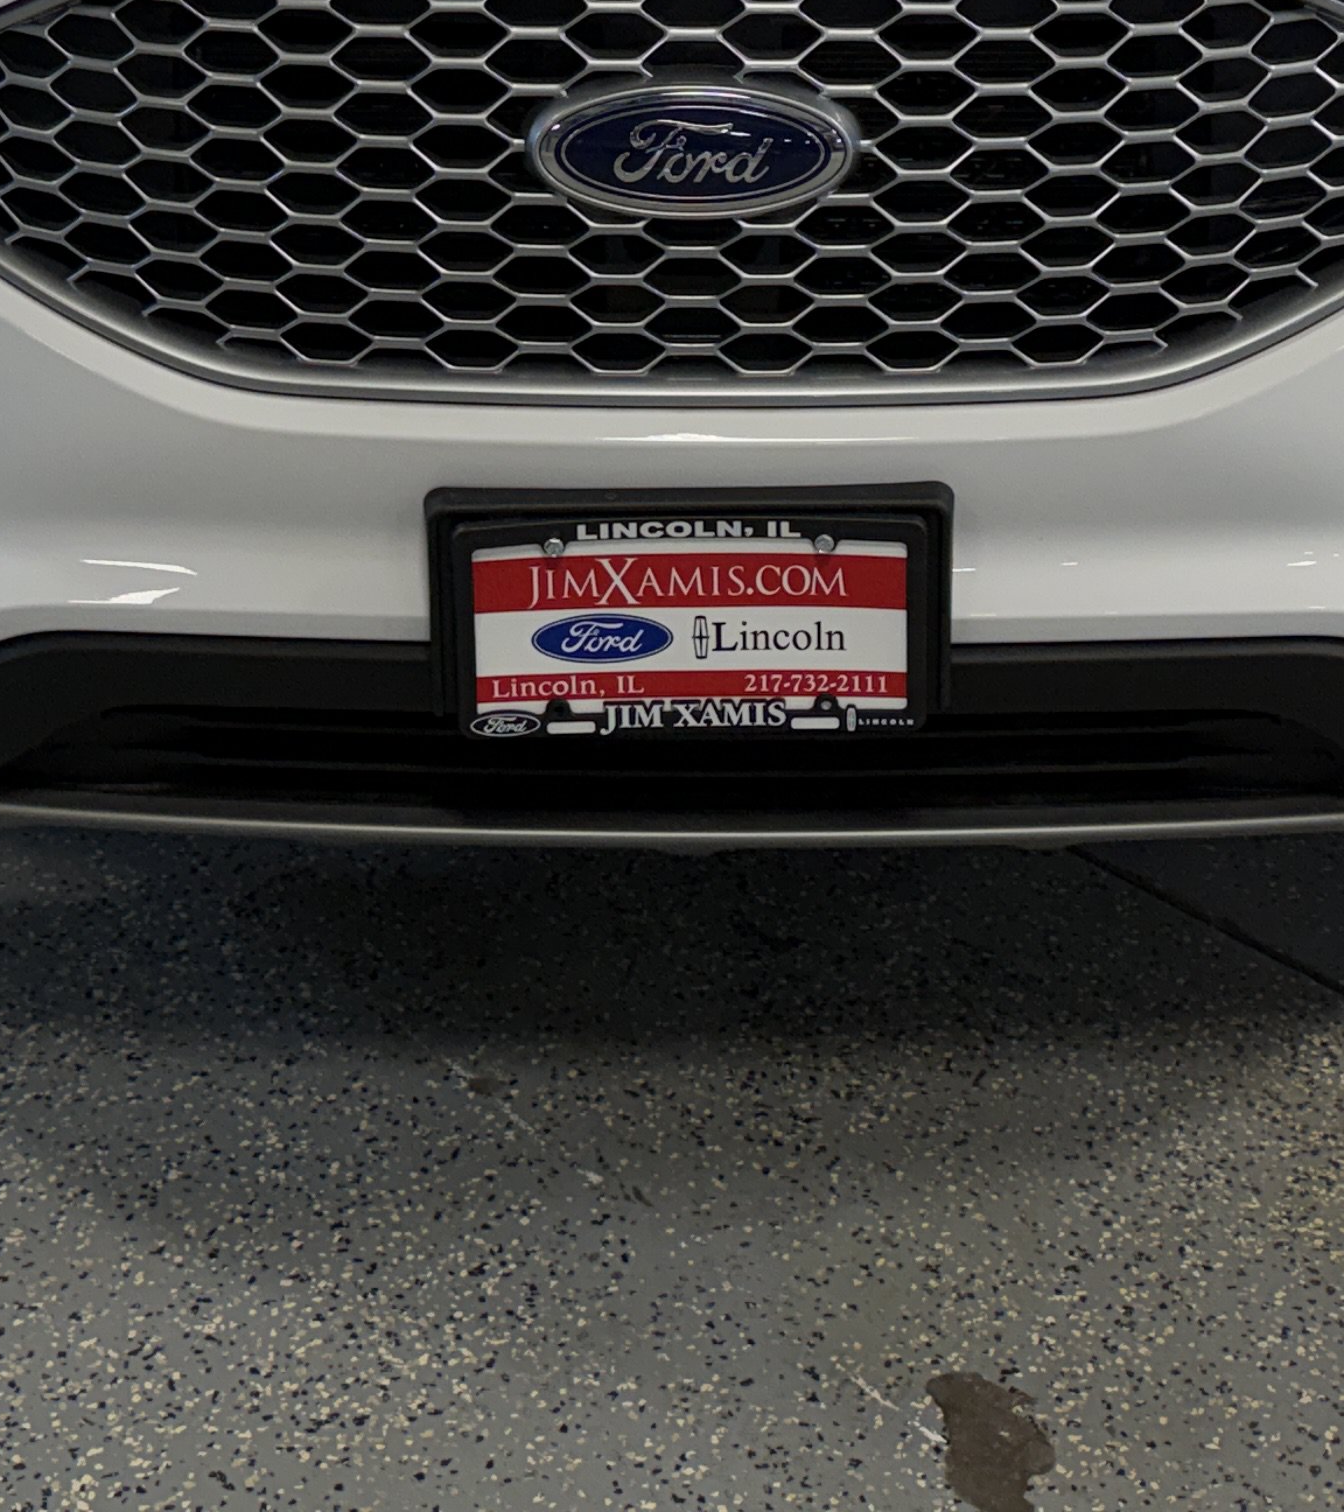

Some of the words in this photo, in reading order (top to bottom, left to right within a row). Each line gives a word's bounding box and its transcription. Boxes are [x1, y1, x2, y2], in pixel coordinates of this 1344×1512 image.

[613, 119, 773, 184] Ford
[576, 521, 753, 539] LINCOLN,
[767, 521, 801, 538] IL
[527, 558, 848, 608] JIMXAMIS.COM
[561, 622, 643, 655] Ford
[711, 622, 847, 652] Lincoln
[492, 677, 605, 698] Lincoln,
[617, 676, 644, 693] IL
[744, 673, 888, 692] 217-732-2111
[484, 717, 527, 734] Ford
[600, 705, 664, 735] JIM
[673, 701, 786, 728] XAMIS
